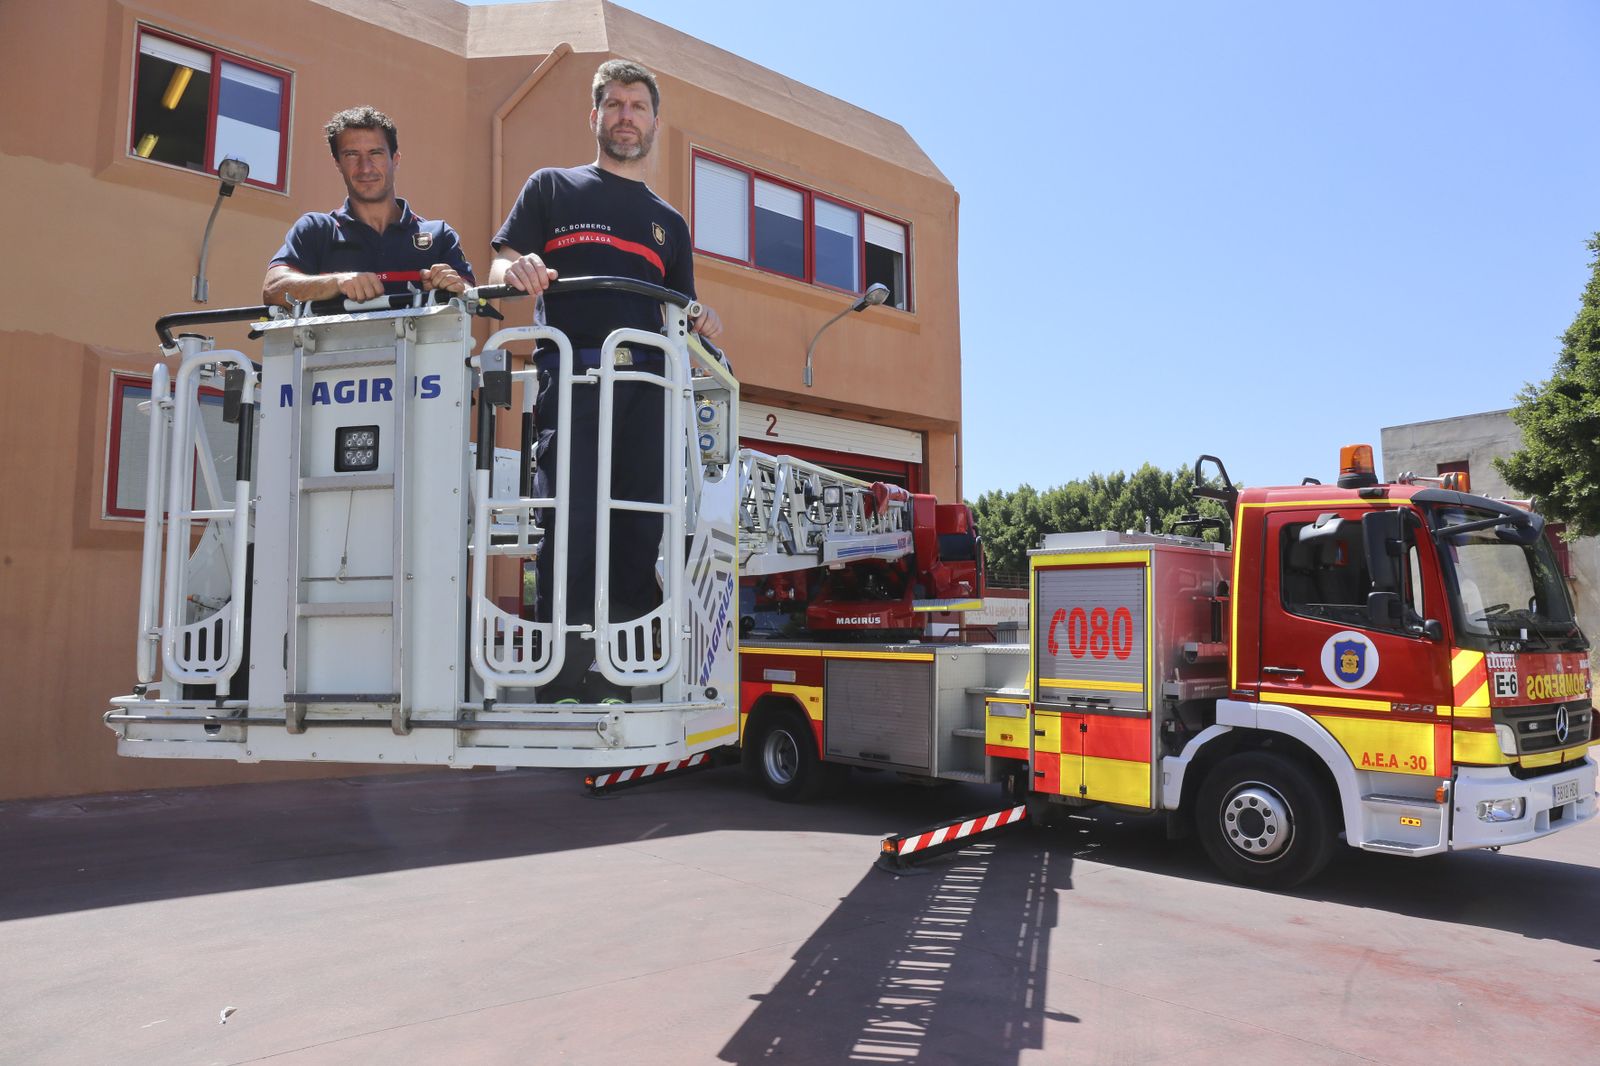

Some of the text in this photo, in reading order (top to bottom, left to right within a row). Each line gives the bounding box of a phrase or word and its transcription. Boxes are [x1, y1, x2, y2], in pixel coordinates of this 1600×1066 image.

[569, 223, 612, 232] BOMBEROS
[579, 235, 612, 243] MALAGA
[765, 413, 779, 437] 2
[699, 571, 734, 687] MAGIRUS
[836, 616, 881, 625] MAGIRUS
[1068, 606, 1133, 661] 080
[1495, 674, 1517, 695] E-6
